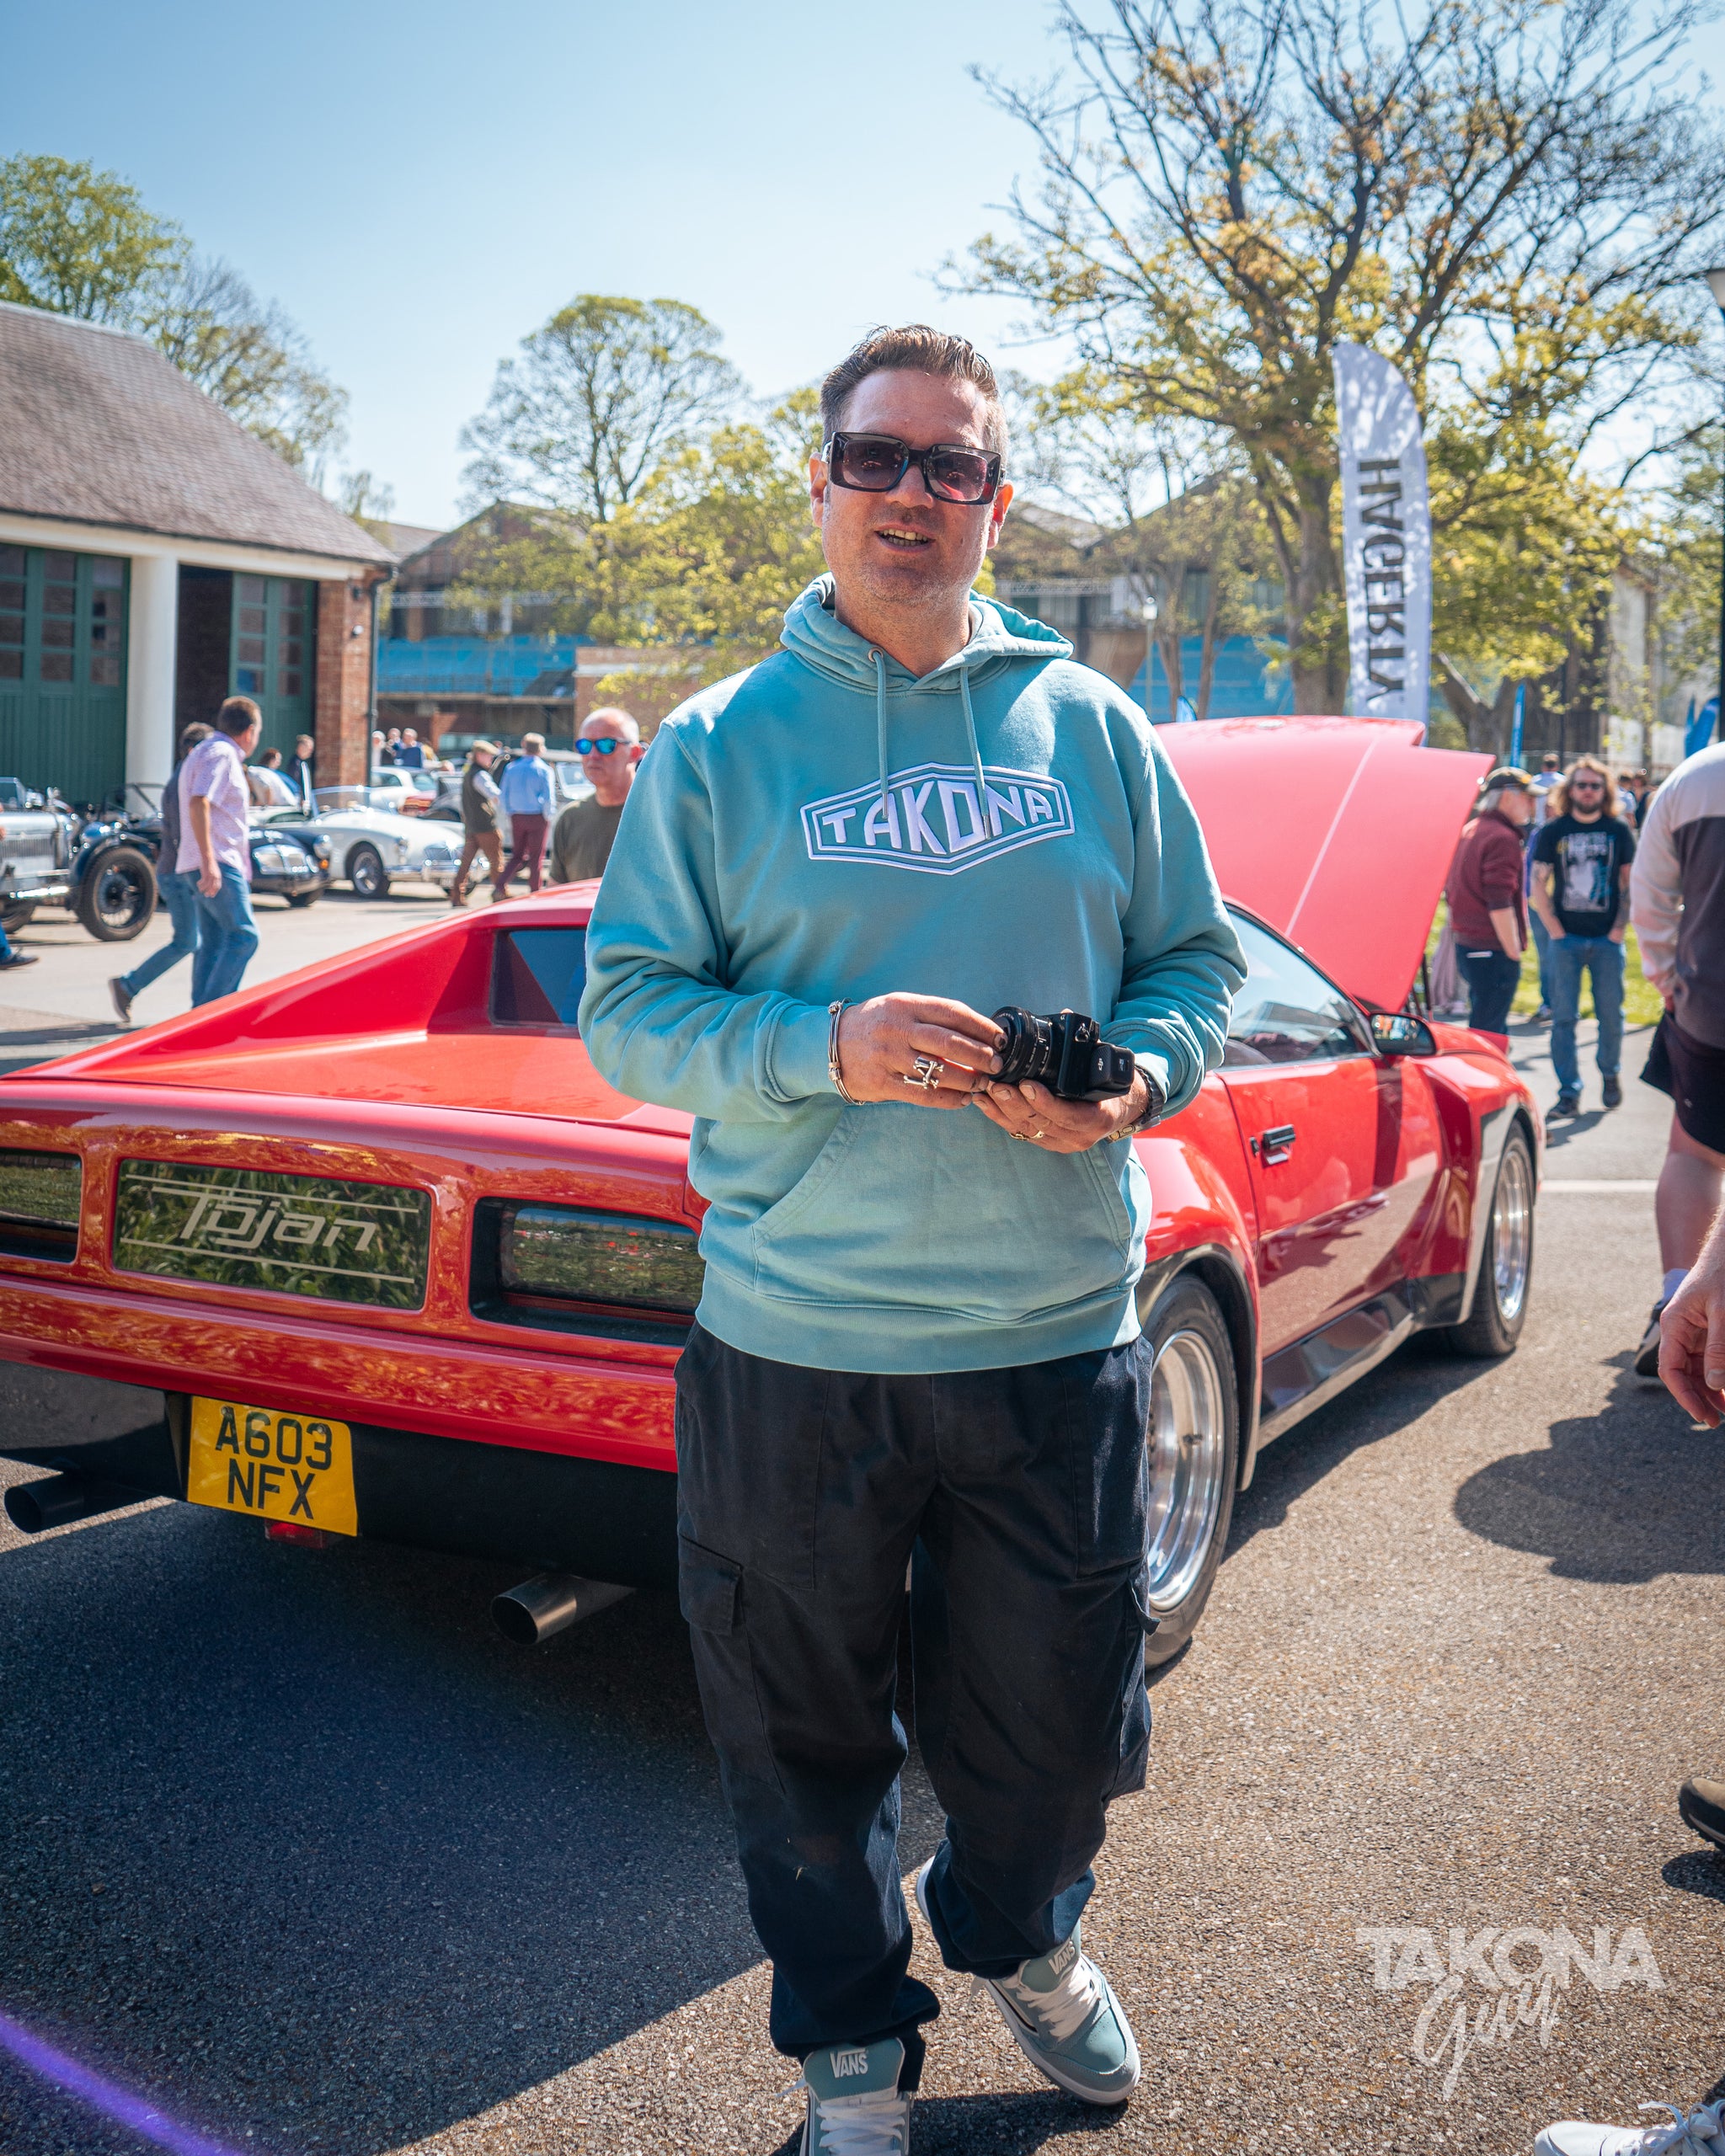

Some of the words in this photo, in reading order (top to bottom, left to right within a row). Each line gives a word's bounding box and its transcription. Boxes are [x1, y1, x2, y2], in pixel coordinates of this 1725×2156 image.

[822, 780, 1054, 855] TAKONA
[151, 1186, 377, 1252] Tojan
[215, 1406, 333, 1471] A603
[227, 1458, 316, 1520] NFX
[1048, 1937, 1076, 1975] VANS
[830, 2047, 868, 2079] VANS
